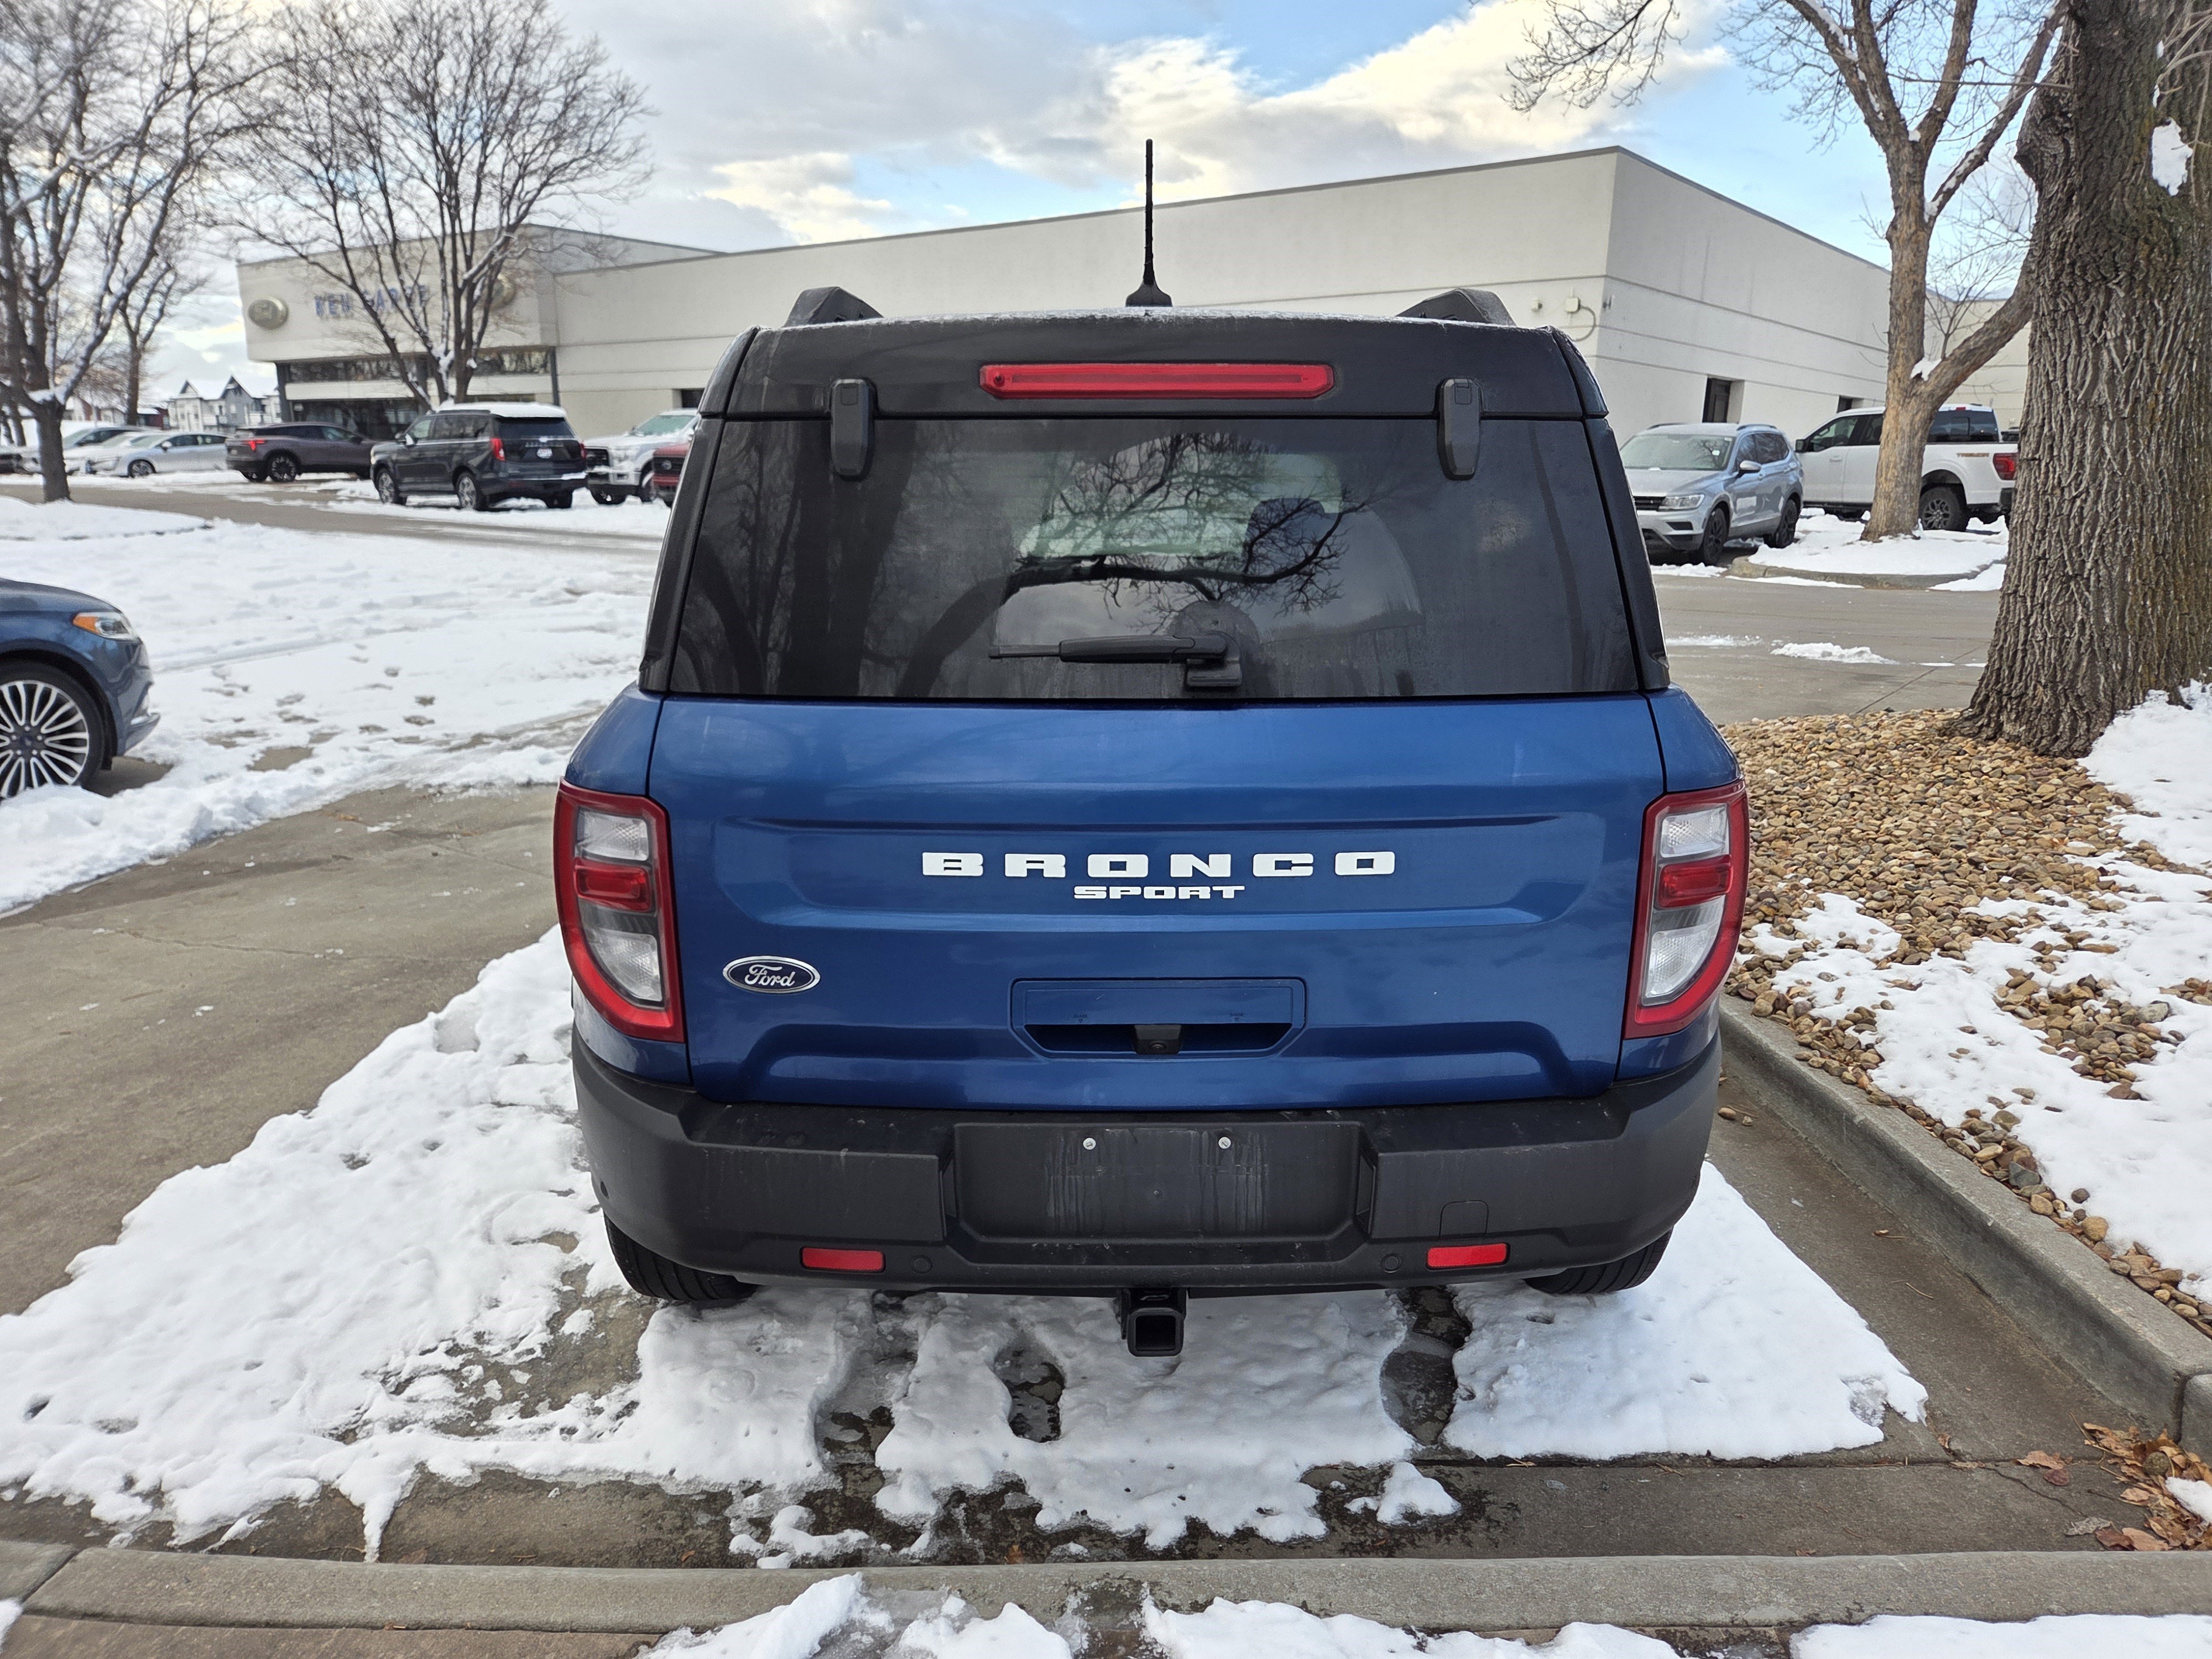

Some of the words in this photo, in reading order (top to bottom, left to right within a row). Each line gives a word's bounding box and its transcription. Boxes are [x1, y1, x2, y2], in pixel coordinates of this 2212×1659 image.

[922, 852, 1395, 877] BRONCO
[1074, 886, 1245, 899] SPORT
[744, 964, 795, 987] Ford
